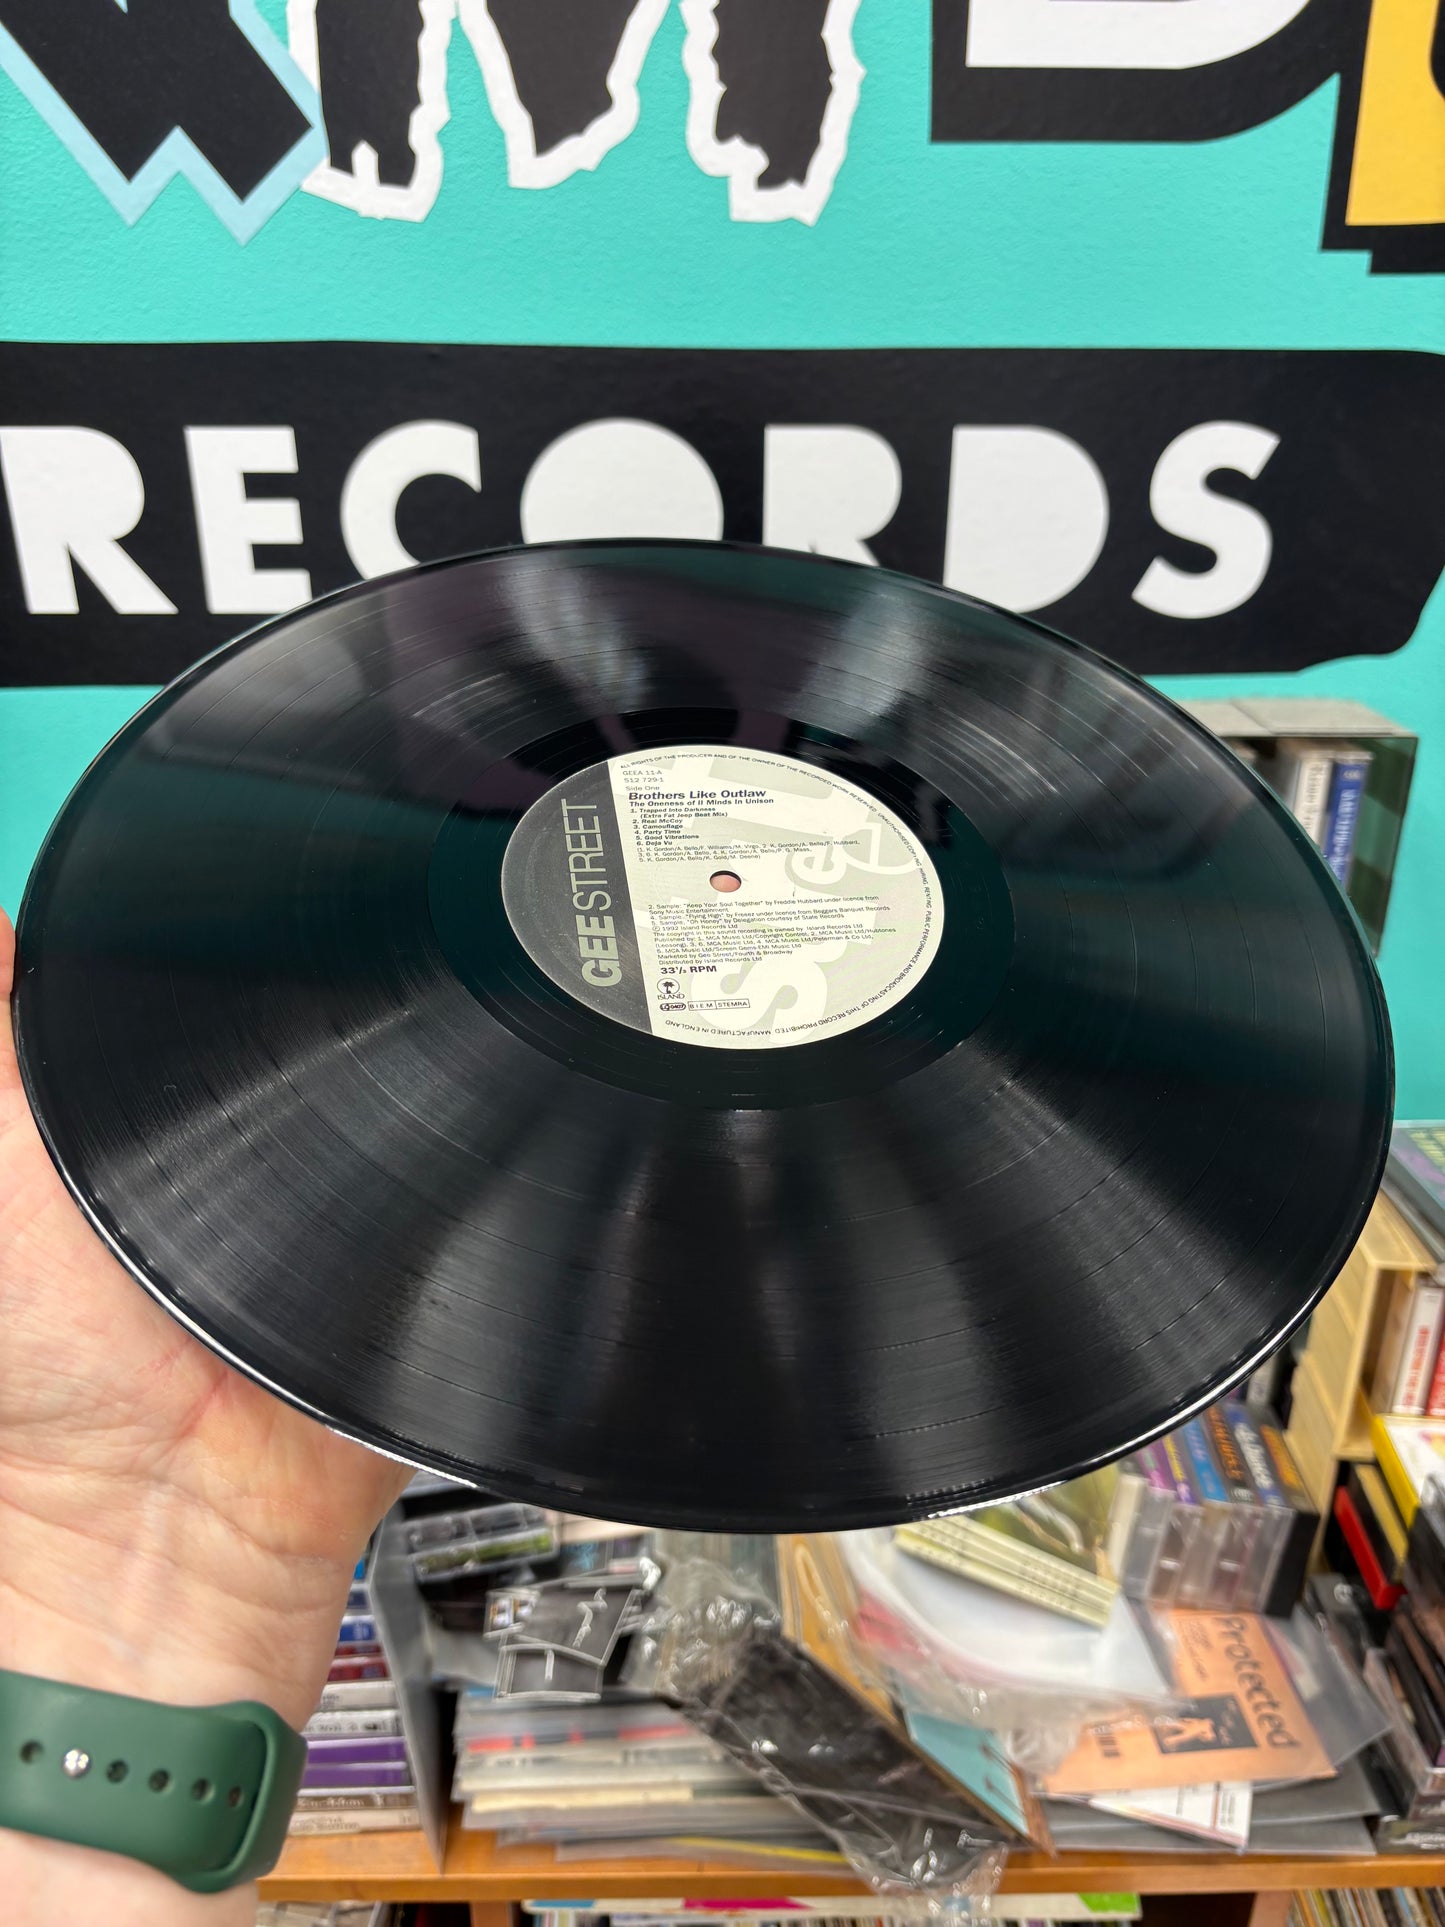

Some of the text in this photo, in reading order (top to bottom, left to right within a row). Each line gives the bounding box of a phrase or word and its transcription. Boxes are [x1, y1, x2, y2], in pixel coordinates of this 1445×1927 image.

[0, 418, 1280, 618] RECORDS
[628, 789, 767, 801] Brothers Like Outlaw
[689, 965, 717, 973] RPM
[665, 1019, 700, 1032] ENGLAND
[1211, 1616, 1302, 1748] Protected
